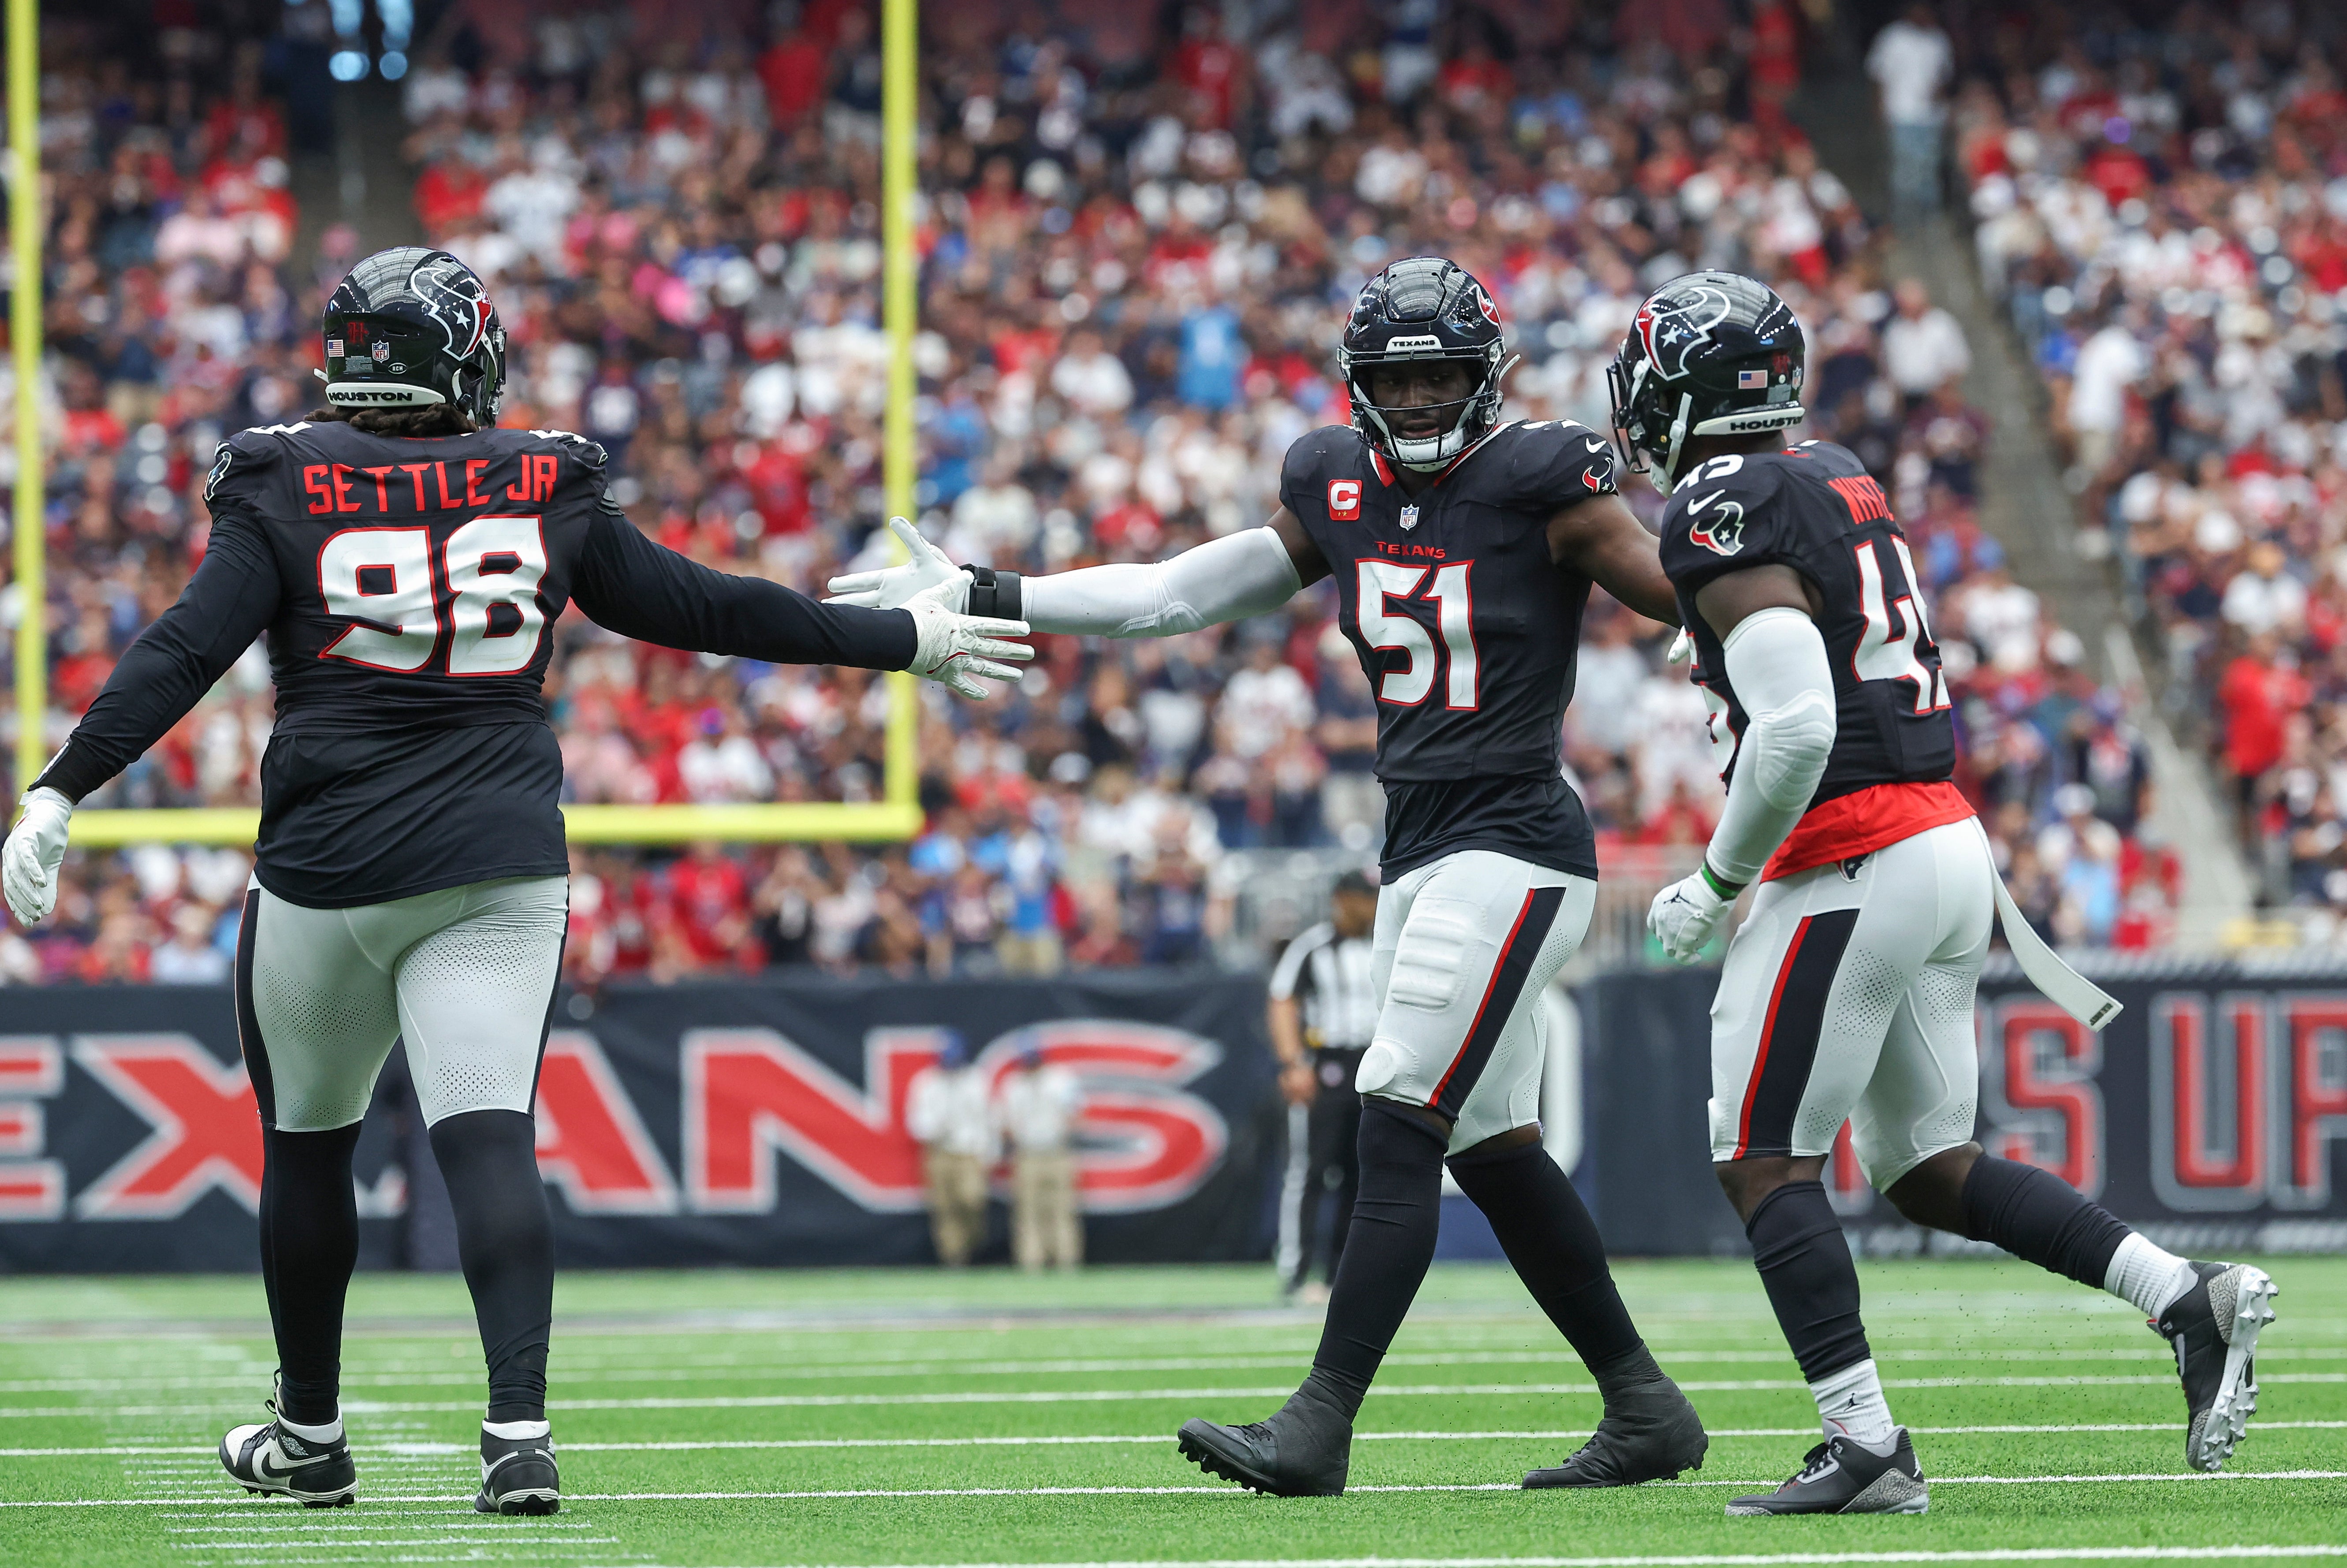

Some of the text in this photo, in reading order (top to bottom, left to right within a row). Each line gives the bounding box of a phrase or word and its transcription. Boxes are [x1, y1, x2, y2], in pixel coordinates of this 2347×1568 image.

[374, 350, 387, 359] NFL
[328, 391, 413, 402] HOUSTON
[303, 454, 558, 514] SETTLE JR
[1330, 482, 1359, 510] C
[1403, 516, 1415, 525] NFL
[1374, 540, 1446, 559] TEXANS
[317, 514, 549, 678] 98
[1355, 558, 1480, 712] 51
